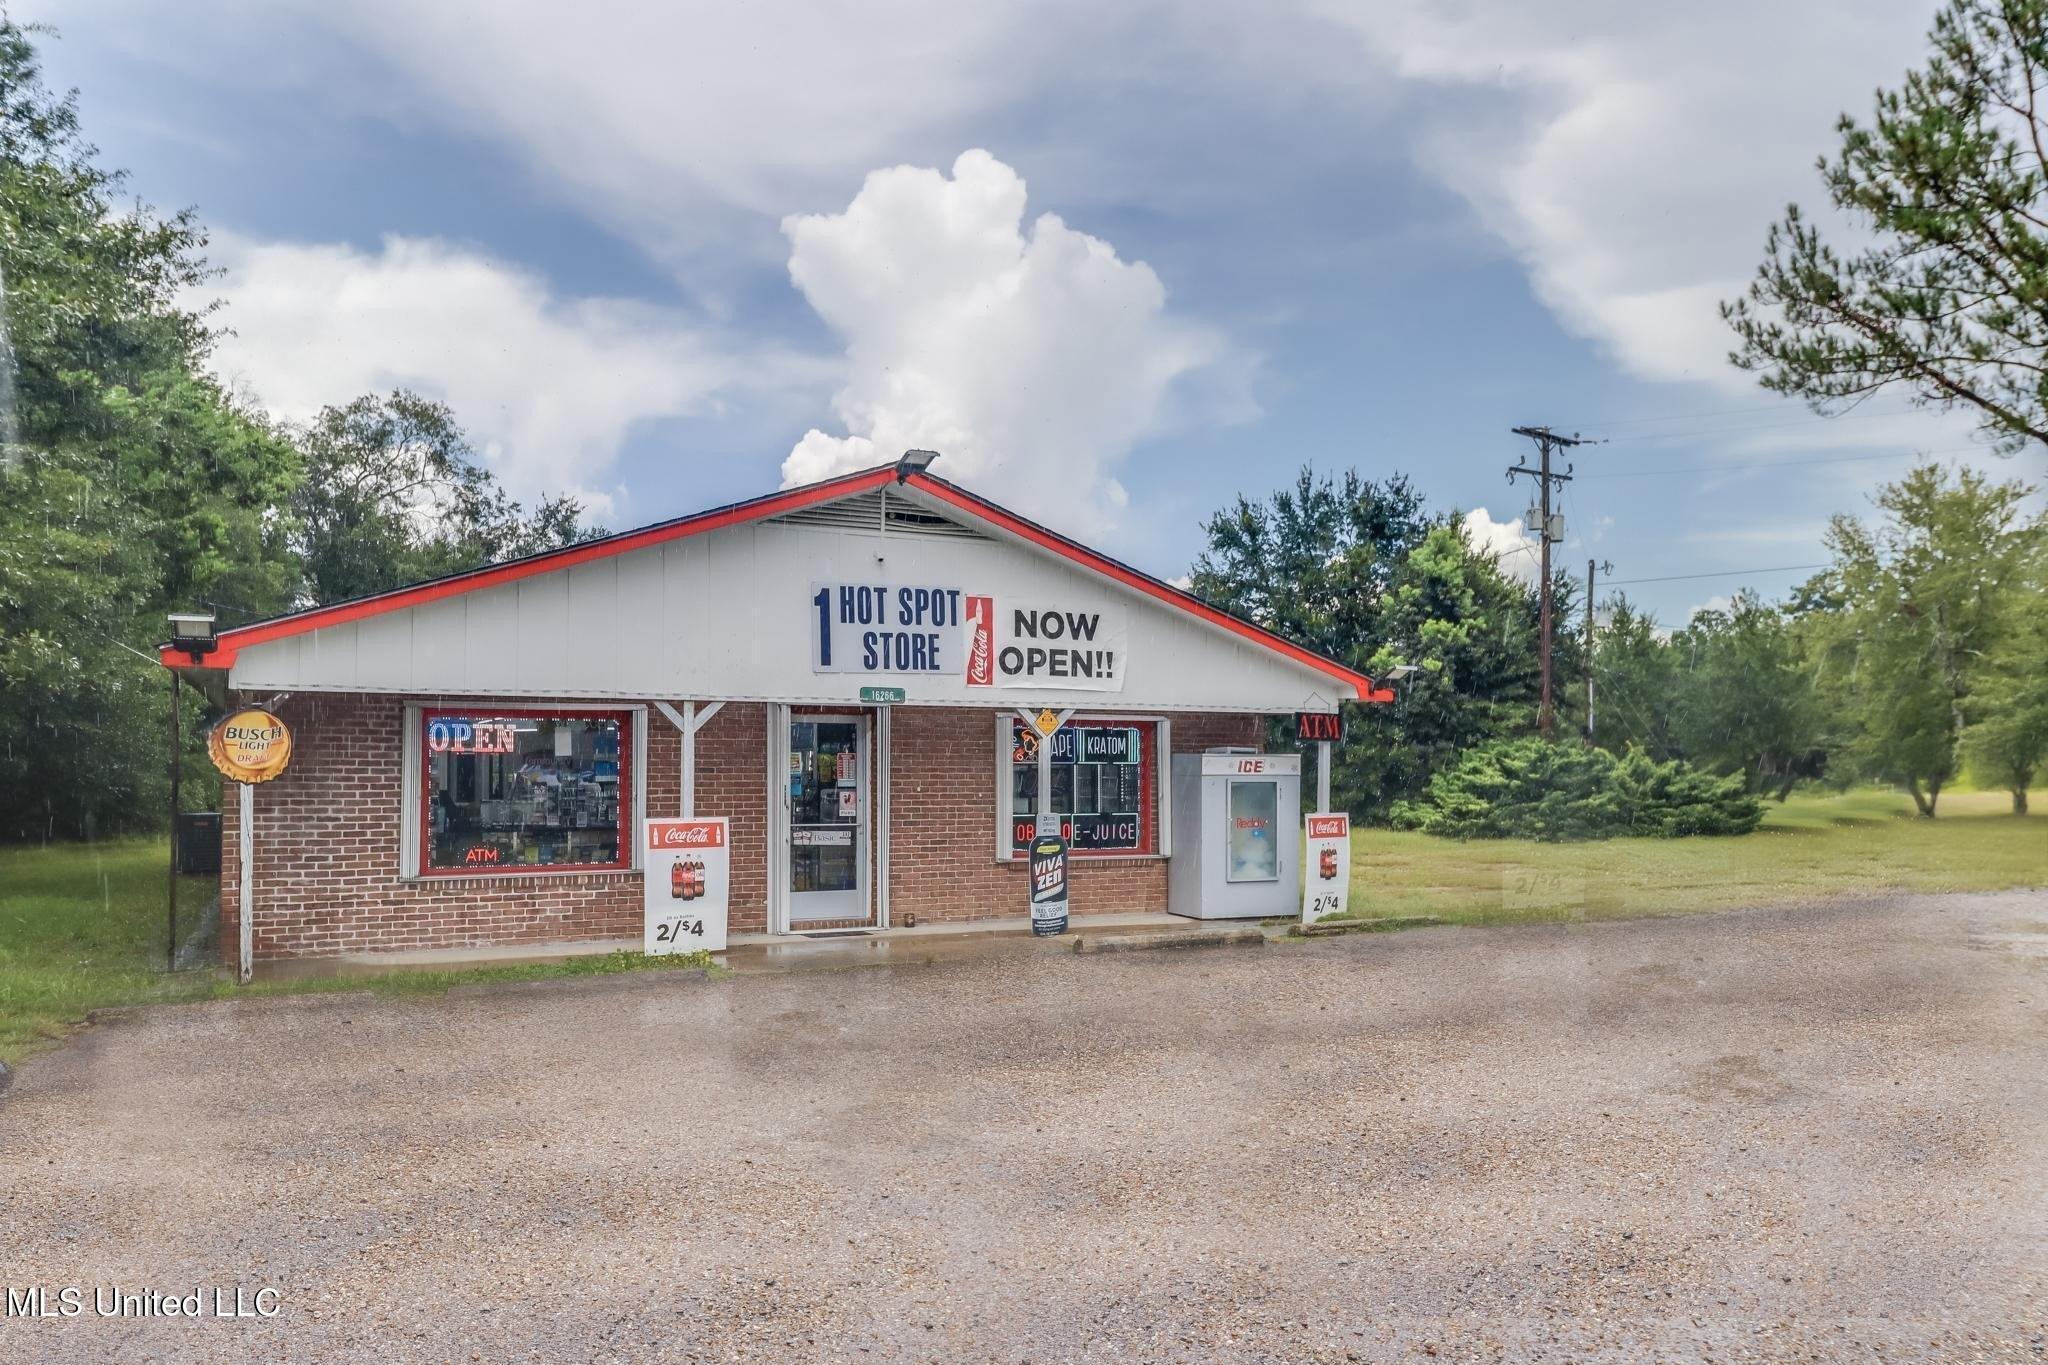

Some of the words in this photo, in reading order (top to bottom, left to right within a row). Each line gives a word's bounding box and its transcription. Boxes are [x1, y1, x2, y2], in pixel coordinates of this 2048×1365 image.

[840, 586, 887, 624] HOT
[899, 587, 960, 627] SPOT
[814, 588, 831, 666] 1
[1014, 609, 1100, 641] NOW
[863, 631, 940, 671] STORE
[998, 646, 1114, 678] OPEN!!
[225, 726, 282, 740] BUSCH
[1299, 714, 1340, 738] ATM
[239, 741, 270, 751] LIGHT
[429, 723, 517, 752] OPEN
[1050, 734, 1073, 757] APE
[1087, 736, 1126, 755] KRATOM
[1238, 760, 1264, 773] ICE
[665, 827, 710, 843] Coca-Cola
[1074, 823, 1135, 840] E-JUICE
[466, 848, 497, 863] ATM
[1034, 854, 1063, 876] VIVA
[1313, 896, 1338, 913] 2/$4
[657, 919, 704, 943] 2/$4
